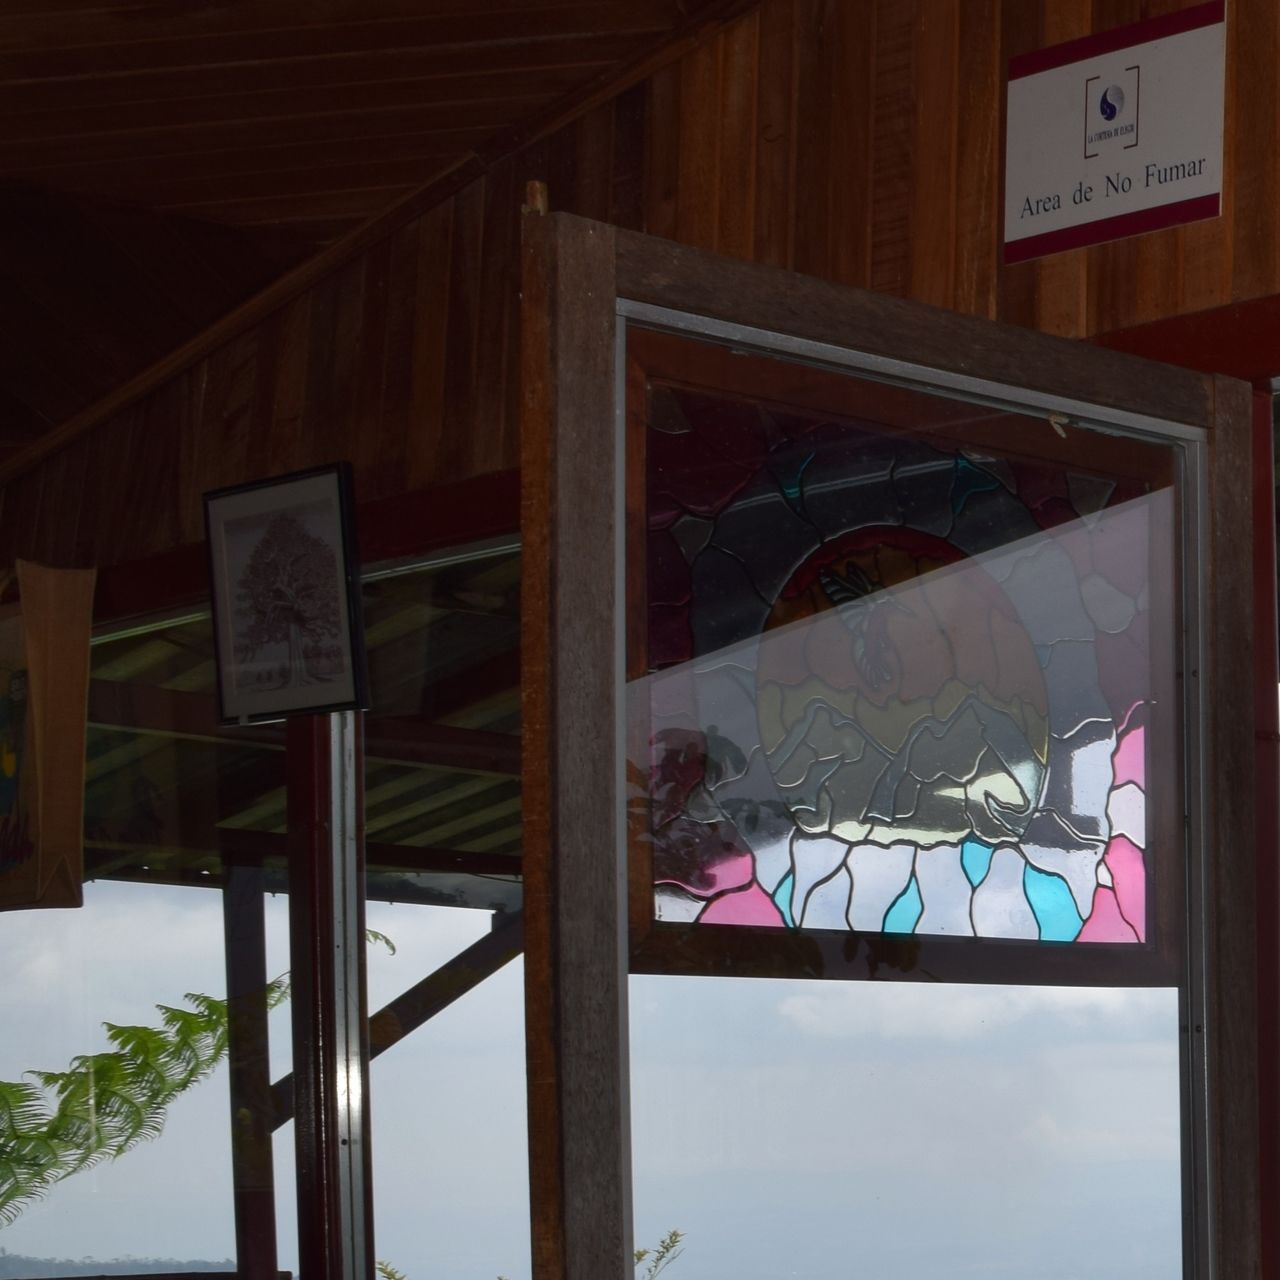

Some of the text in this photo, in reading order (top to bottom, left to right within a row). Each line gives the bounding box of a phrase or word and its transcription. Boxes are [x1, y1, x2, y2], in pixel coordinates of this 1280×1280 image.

[1020, 158, 1206, 219] Area de No Fumar
